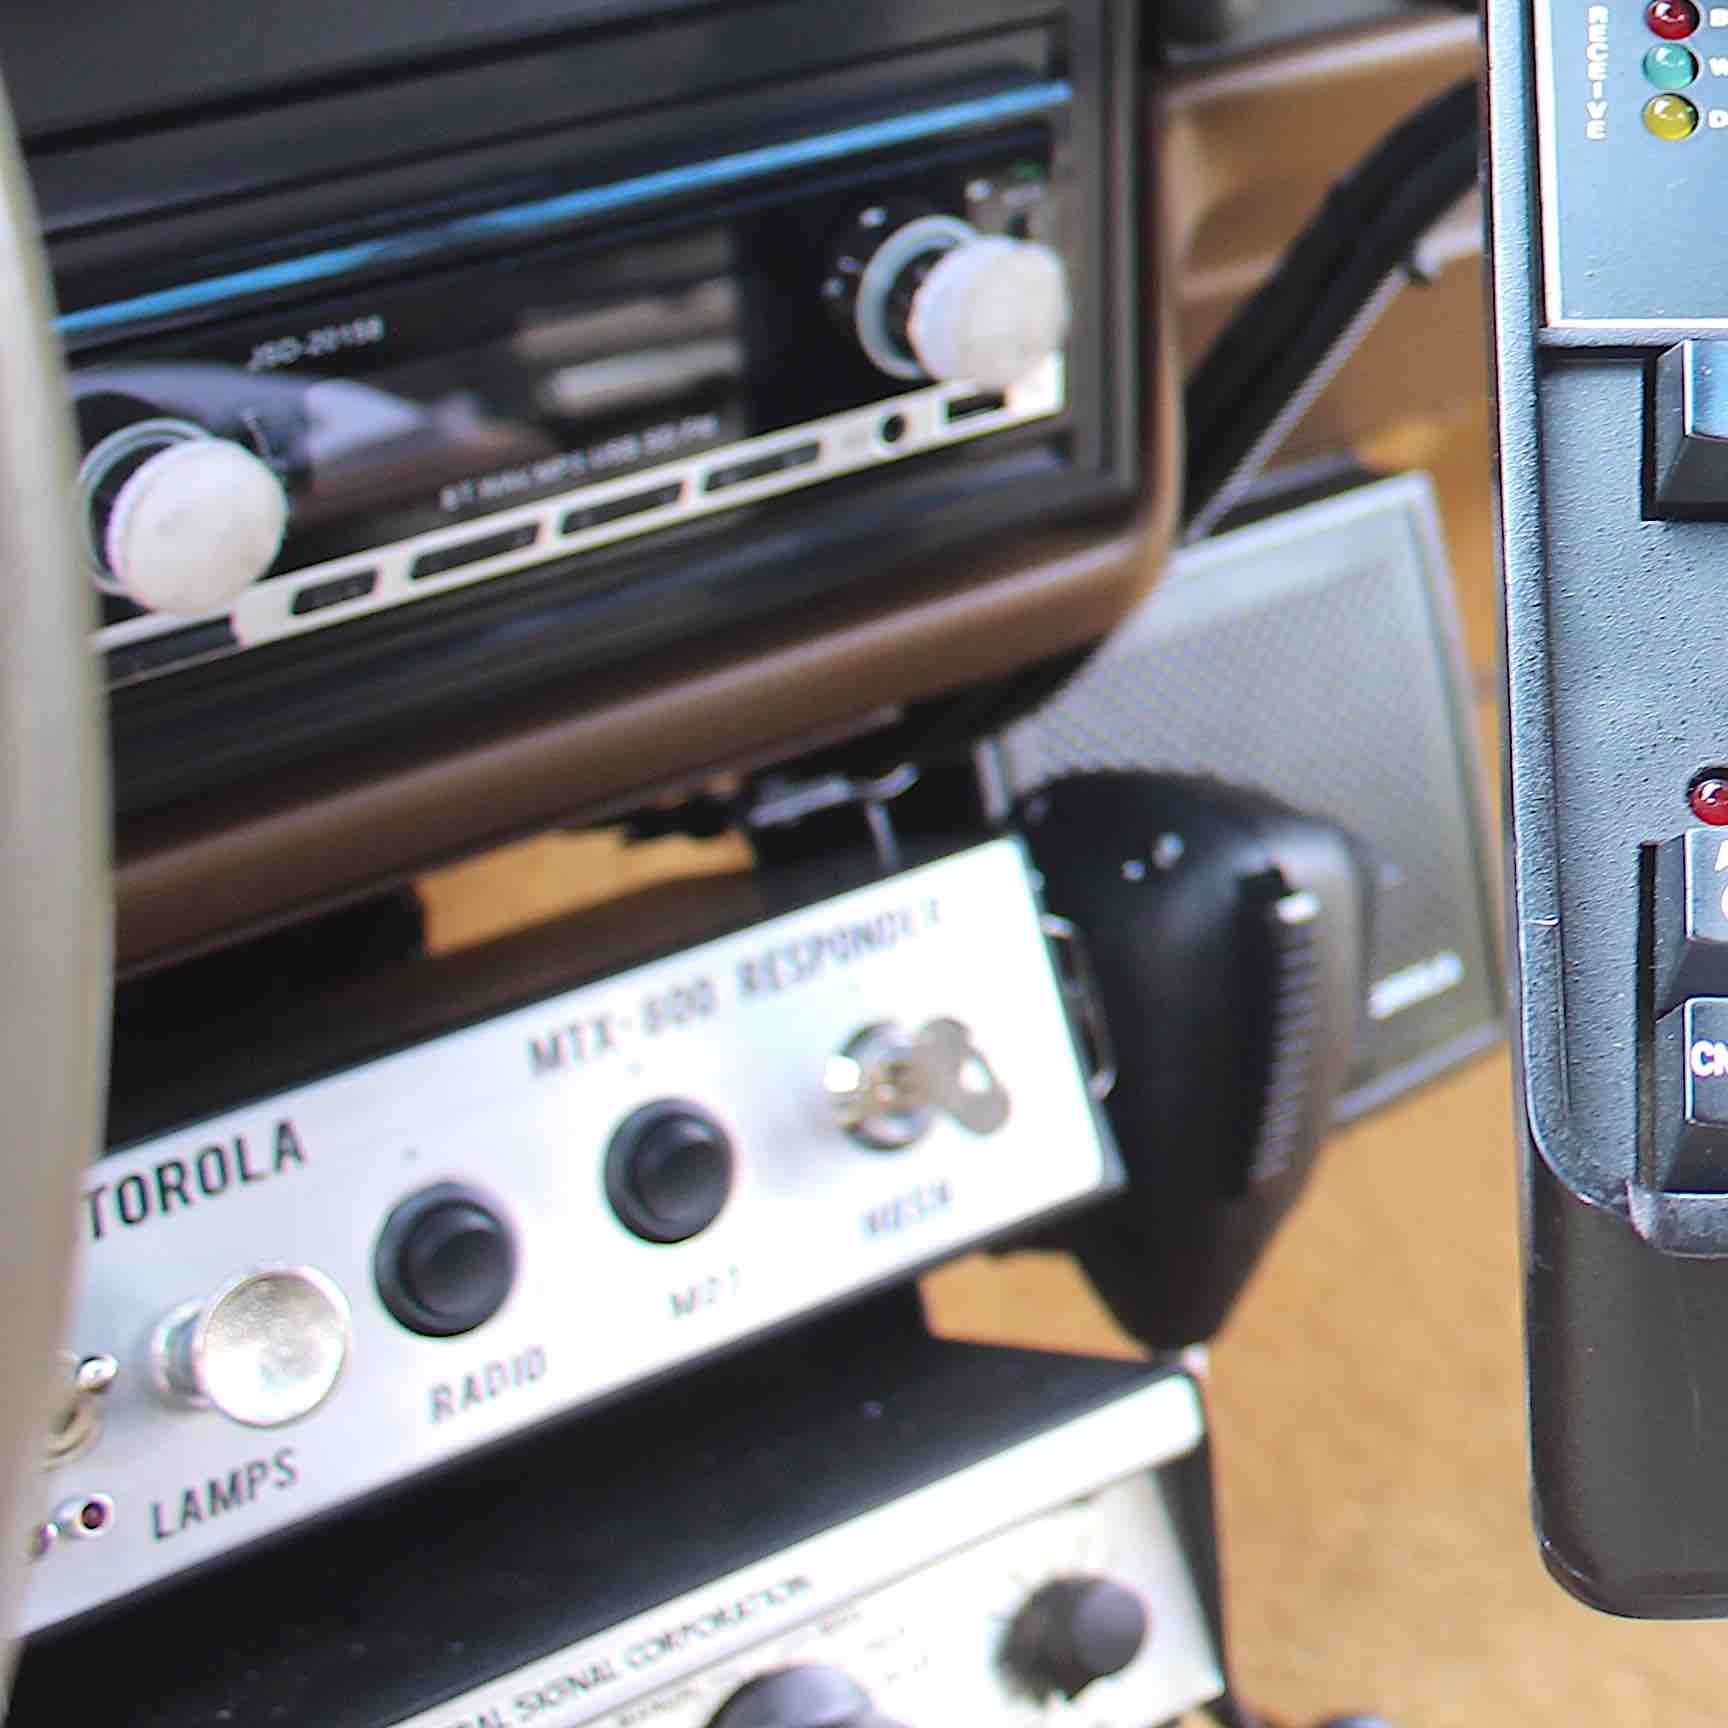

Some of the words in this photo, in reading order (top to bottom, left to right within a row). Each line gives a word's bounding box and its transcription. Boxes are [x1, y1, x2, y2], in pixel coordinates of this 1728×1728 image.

[1586, 4, 1609, 141] RECEIVE
[84, 1119, 307, 1241] TOROLA
[427, 1344, 546, 1427] RADIO
[149, 1446, 297, 1543] LAMPS
